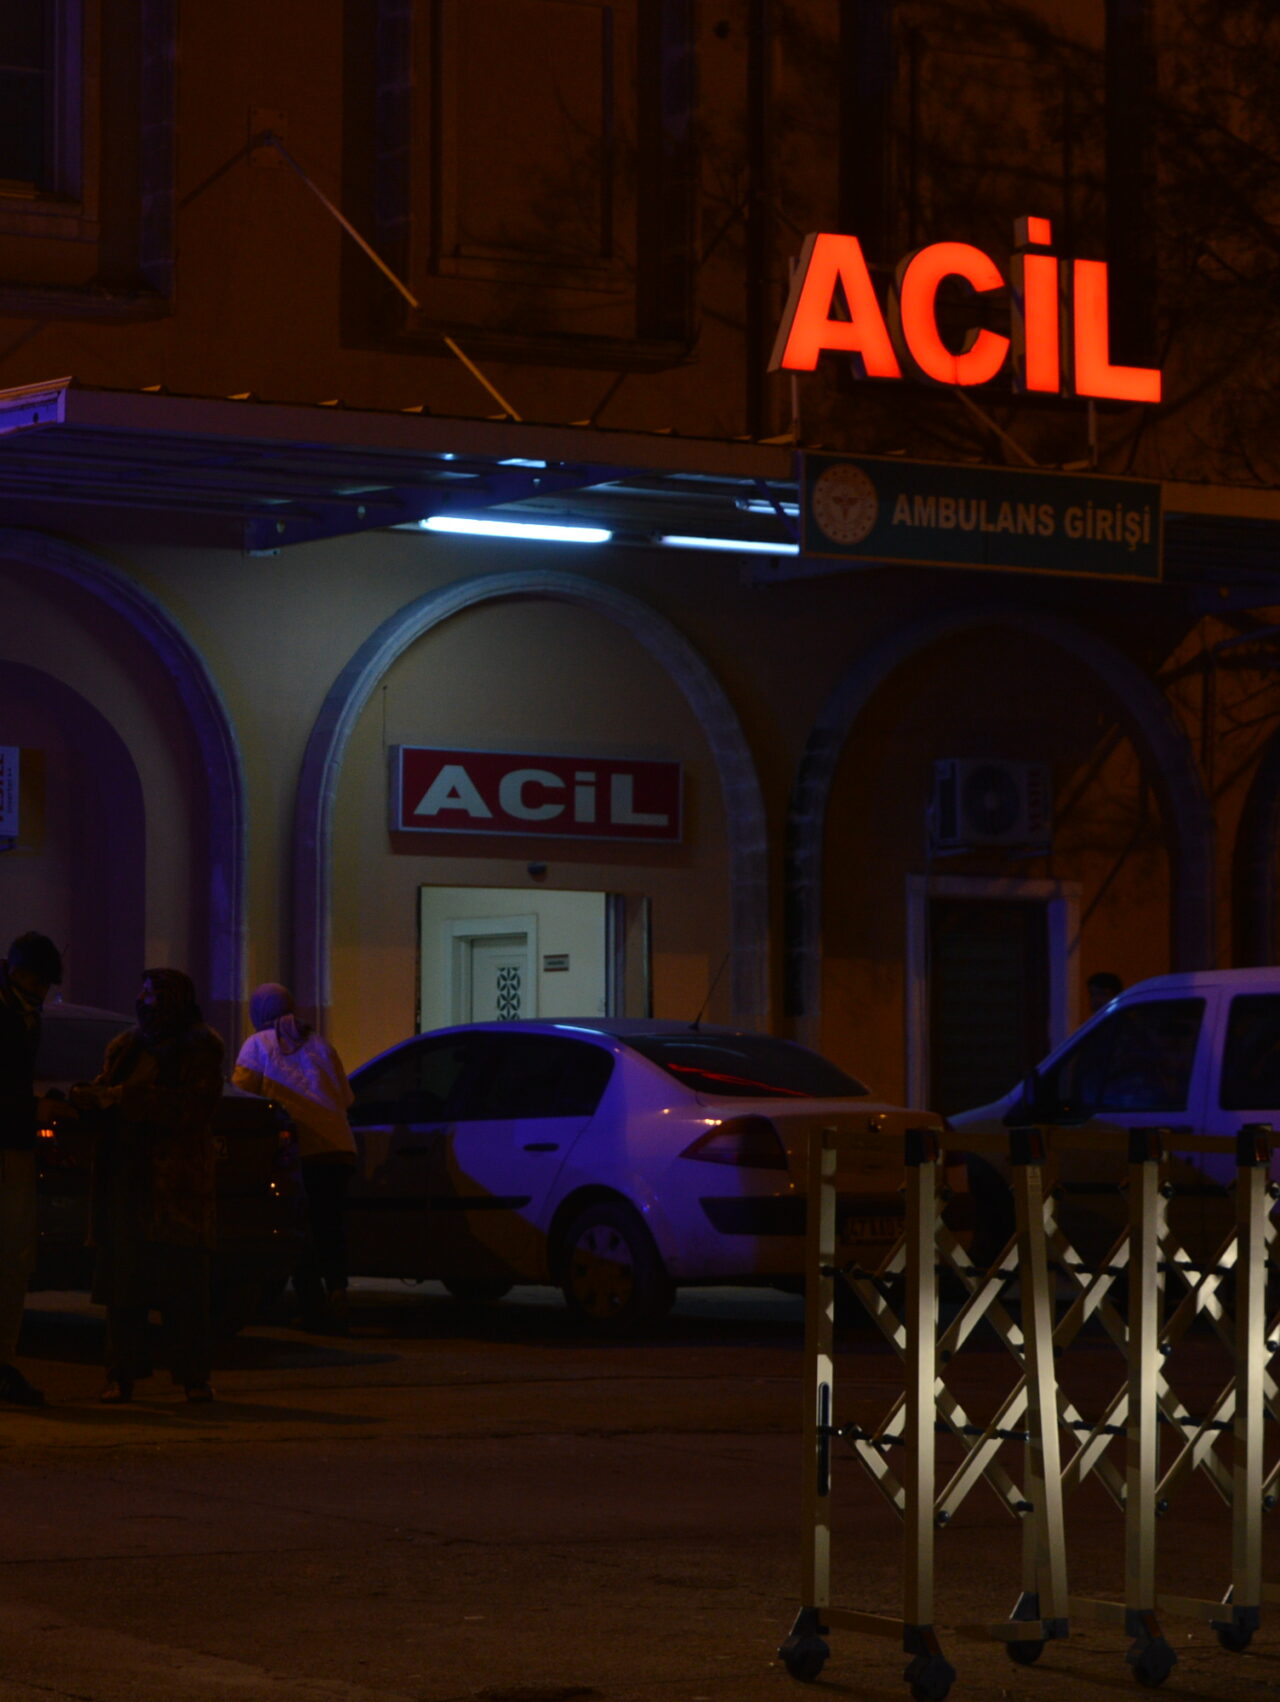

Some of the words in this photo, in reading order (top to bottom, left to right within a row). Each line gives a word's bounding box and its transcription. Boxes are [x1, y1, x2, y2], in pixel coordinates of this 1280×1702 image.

[776, 216, 1163, 403] ACİL
[891, 493, 1056, 537] AMBULANS
[1064, 500, 1152, 551] GİRİŞİ
